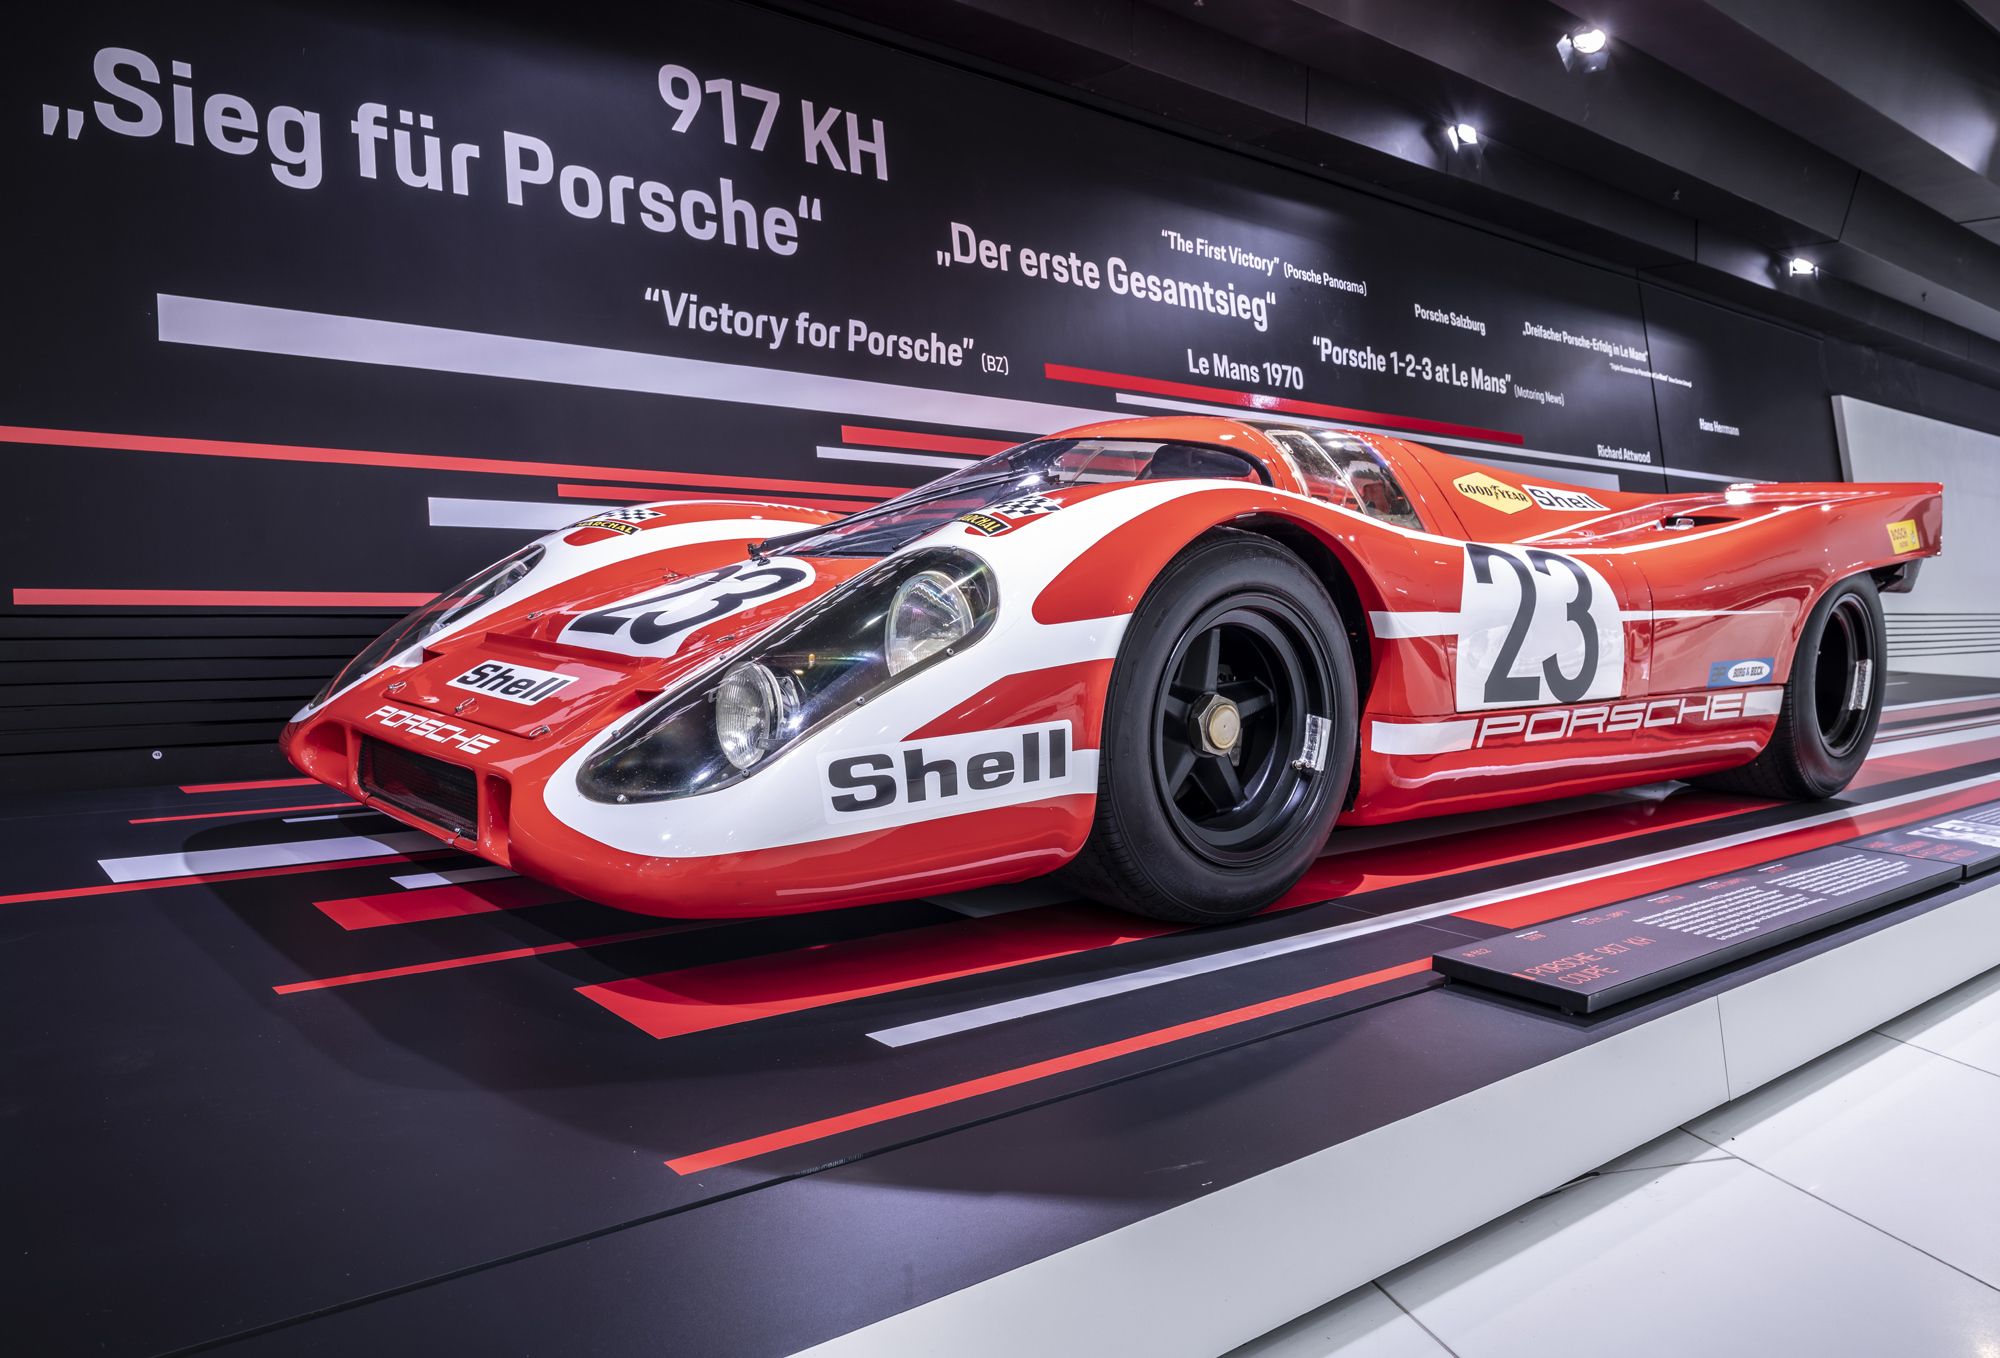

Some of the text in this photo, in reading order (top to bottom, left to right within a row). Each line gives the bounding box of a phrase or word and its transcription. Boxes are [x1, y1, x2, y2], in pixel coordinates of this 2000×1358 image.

[43, 47, 322, 189] „Sieg
[351, 103, 480, 195] für
[658, 64, 888, 181] 917 KH
[1020, 247, 1101, 290] erste
[1196, 237, 1227, 262] First
[1283, 261, 1322, 285] (Porsche
[1322, 271, 1367, 297] Panorama)
[796, 312, 841, 349] for
[981, 352, 1009, 375] (BZ)
[1414, 303, 1486, 337] Porsche Salzburg
[1187, 348, 1304, 390] Le Mans 1970
[1389, 351, 1433, 381] 1-2-3
[1435, 363, 1450, 384] at
[1452, 363, 1469, 388] Le
[1514, 384, 1545, 405] (Motoring
[1545, 390, 1565, 407] News)
[1597, 444, 1651, 463] Richard Attwood
[1528, 488, 1605, 509] Shell
[568, 565, 807, 645] 23
[1465, 543, 1599, 702] 23
[456, 664, 571, 702] Shell
[365, 705, 500, 755] PORSCHE
[1476, 693, 1743, 748] PORSCHE
[828, 728, 1065, 812] Shell
[1524, 952, 1603, 977] PORSCHE
